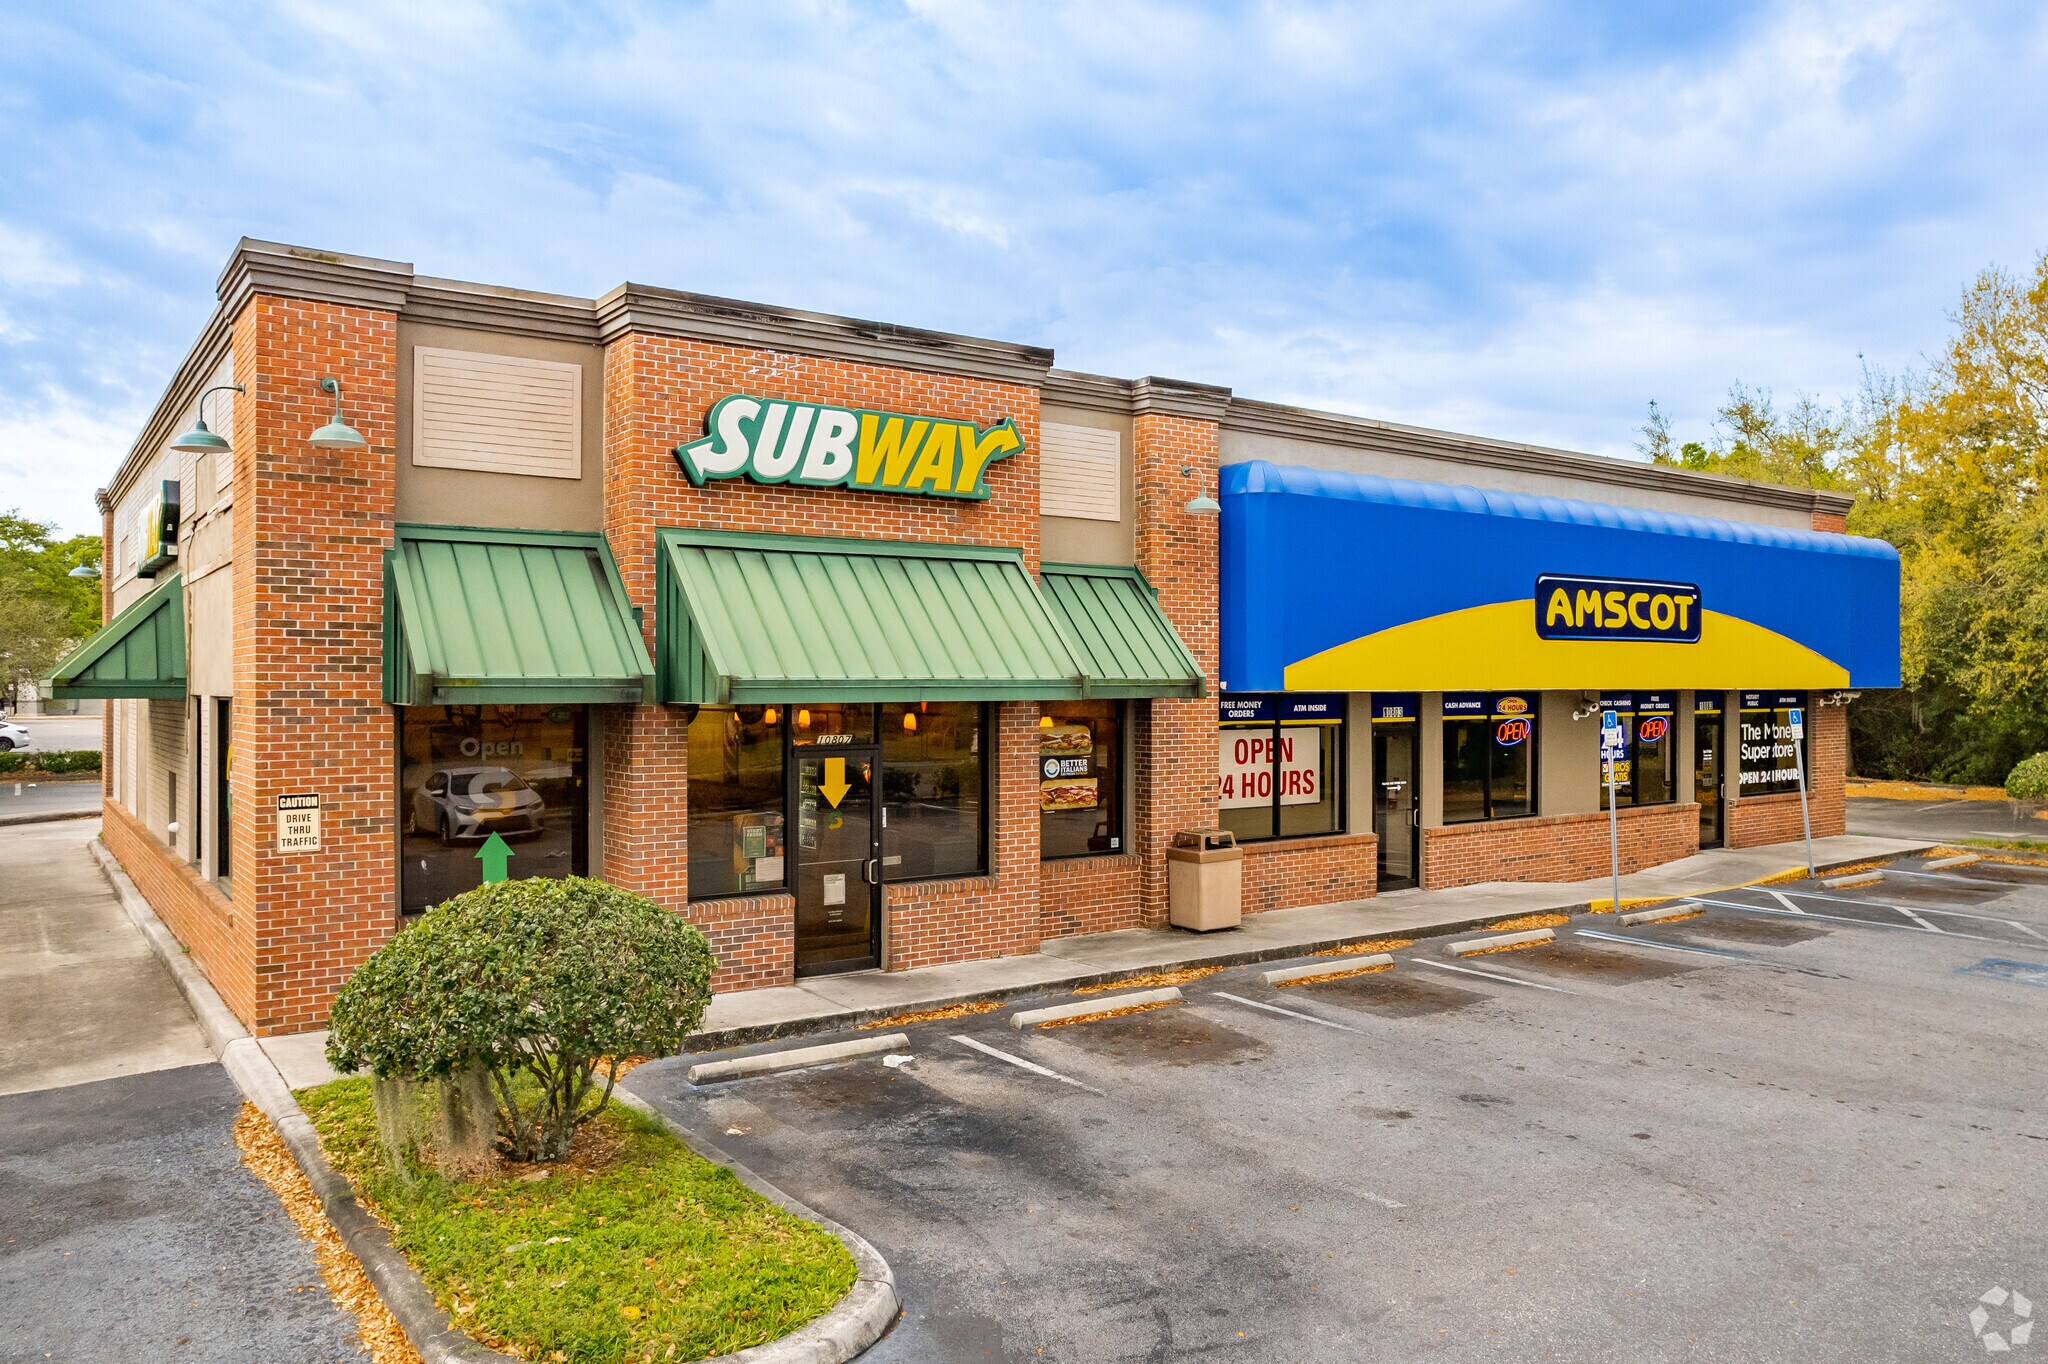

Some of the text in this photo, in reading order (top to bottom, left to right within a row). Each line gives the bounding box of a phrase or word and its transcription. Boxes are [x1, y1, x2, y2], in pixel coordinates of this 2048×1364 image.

[687, 398, 1021, 494] SUBWAY
[1546, 587, 1694, 632] AMSCOT
[1220, 701, 1263, 709] FREE MONEY
[1293, 704, 1327, 712] ATM INSIDE
[1228, 709, 1255, 718] ORDERS
[1497, 721, 1528, 742] OPEN
[1640, 720, 1665, 738] OPEN
[1741, 723, 1761, 741] The
[818, 735, 852, 745] 10807
[460, 737, 524, 760] Open
[1234, 737, 1293, 765] OPEN
[1060, 759, 1088, 767] BETTER
[1219, 774, 1235, 800] 4
[279, 796, 318, 808] CAUTION
[286, 813, 312, 824] DRIVE
[288, 825, 311, 835] THRU
[281, 836, 318, 847] TRAFFIC
